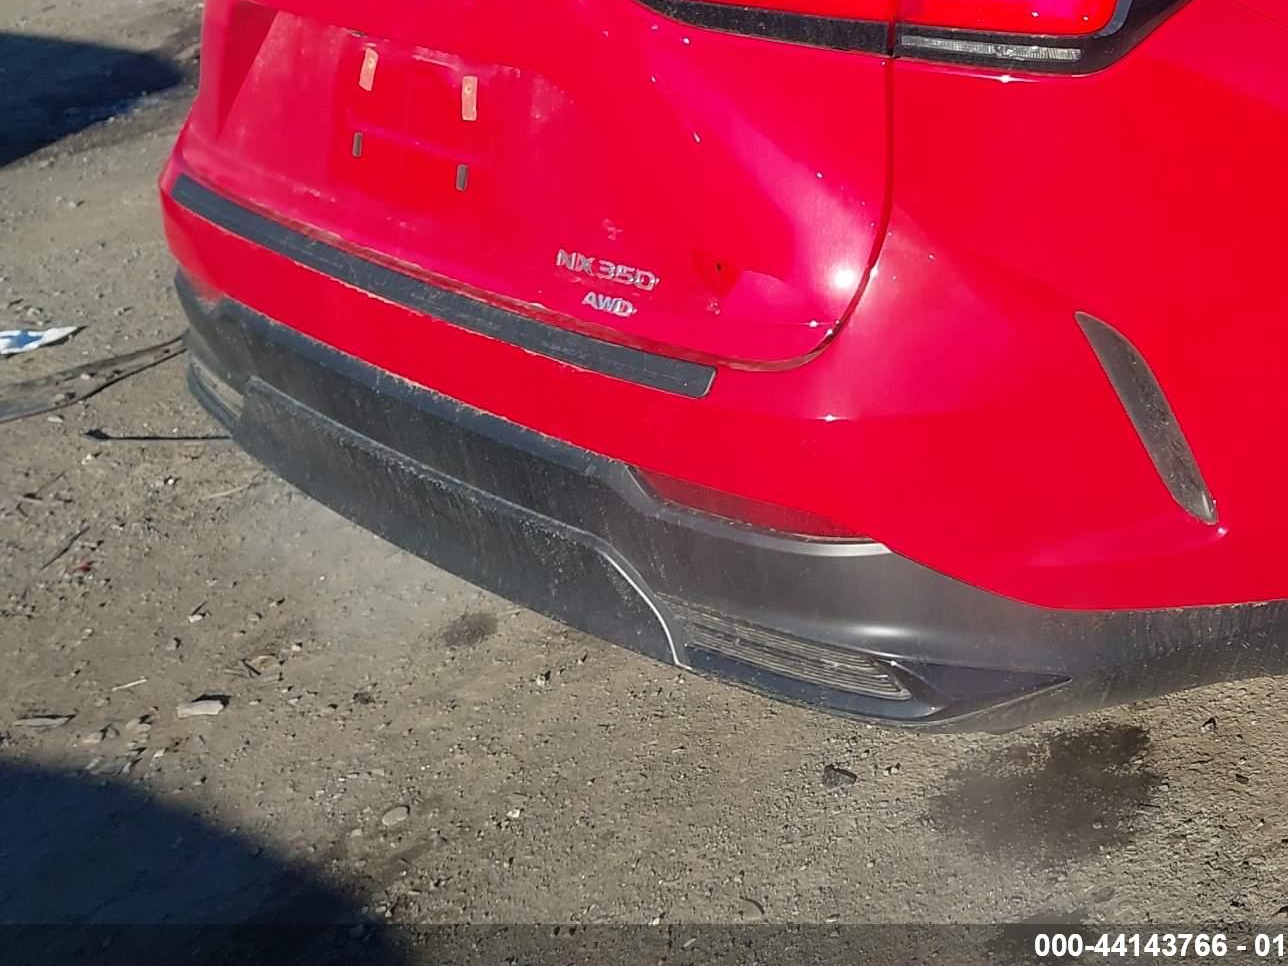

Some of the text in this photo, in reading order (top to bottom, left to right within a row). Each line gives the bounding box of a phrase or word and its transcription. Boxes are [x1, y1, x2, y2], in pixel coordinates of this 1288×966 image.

[556, 248, 659, 291] NX 350
[582, 291, 637, 317] AWD
